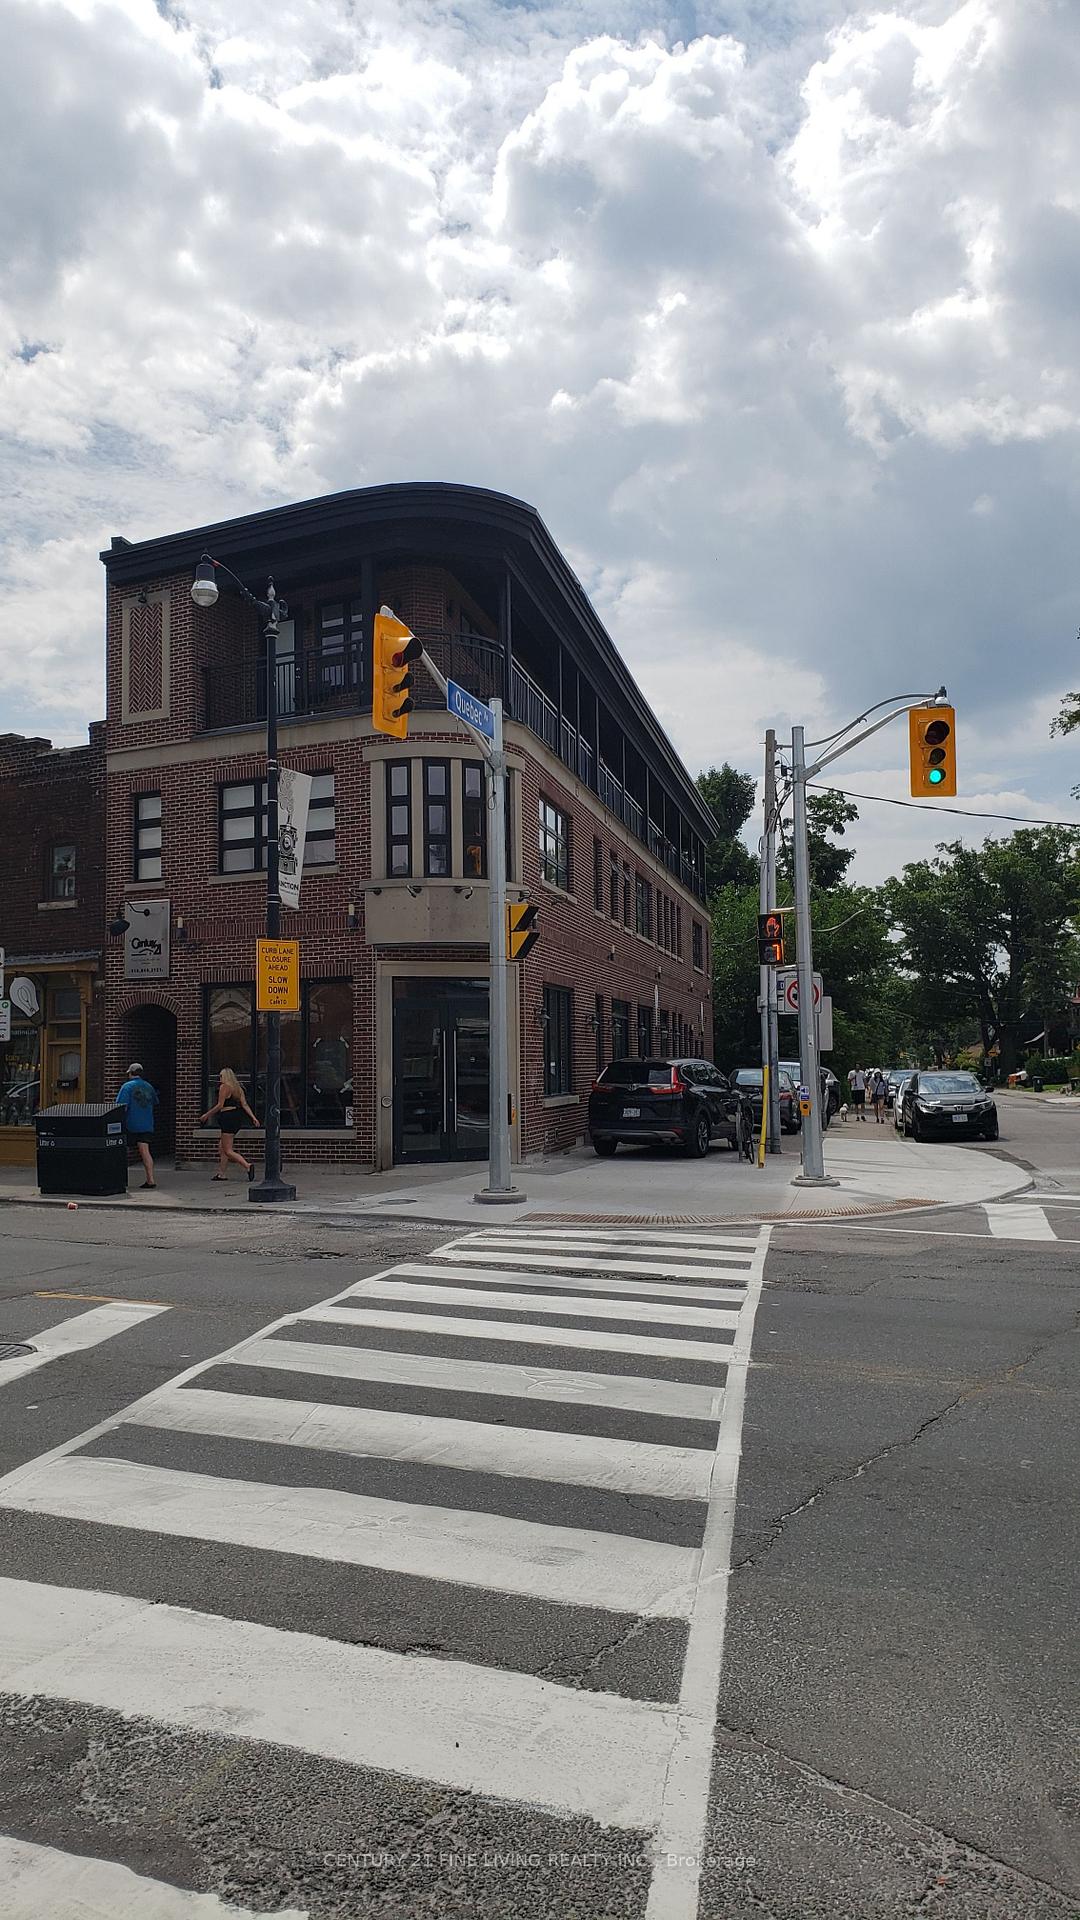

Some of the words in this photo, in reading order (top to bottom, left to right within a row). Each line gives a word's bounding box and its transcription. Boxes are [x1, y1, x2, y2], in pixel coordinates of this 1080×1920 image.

[455, 690, 482, 726] Quebec
[279, 947, 294, 955] LANE
[264, 955, 292, 963] CLOSURE
[268, 975, 288, 984] SLOW
[268, 986, 289, 994] DOWN
